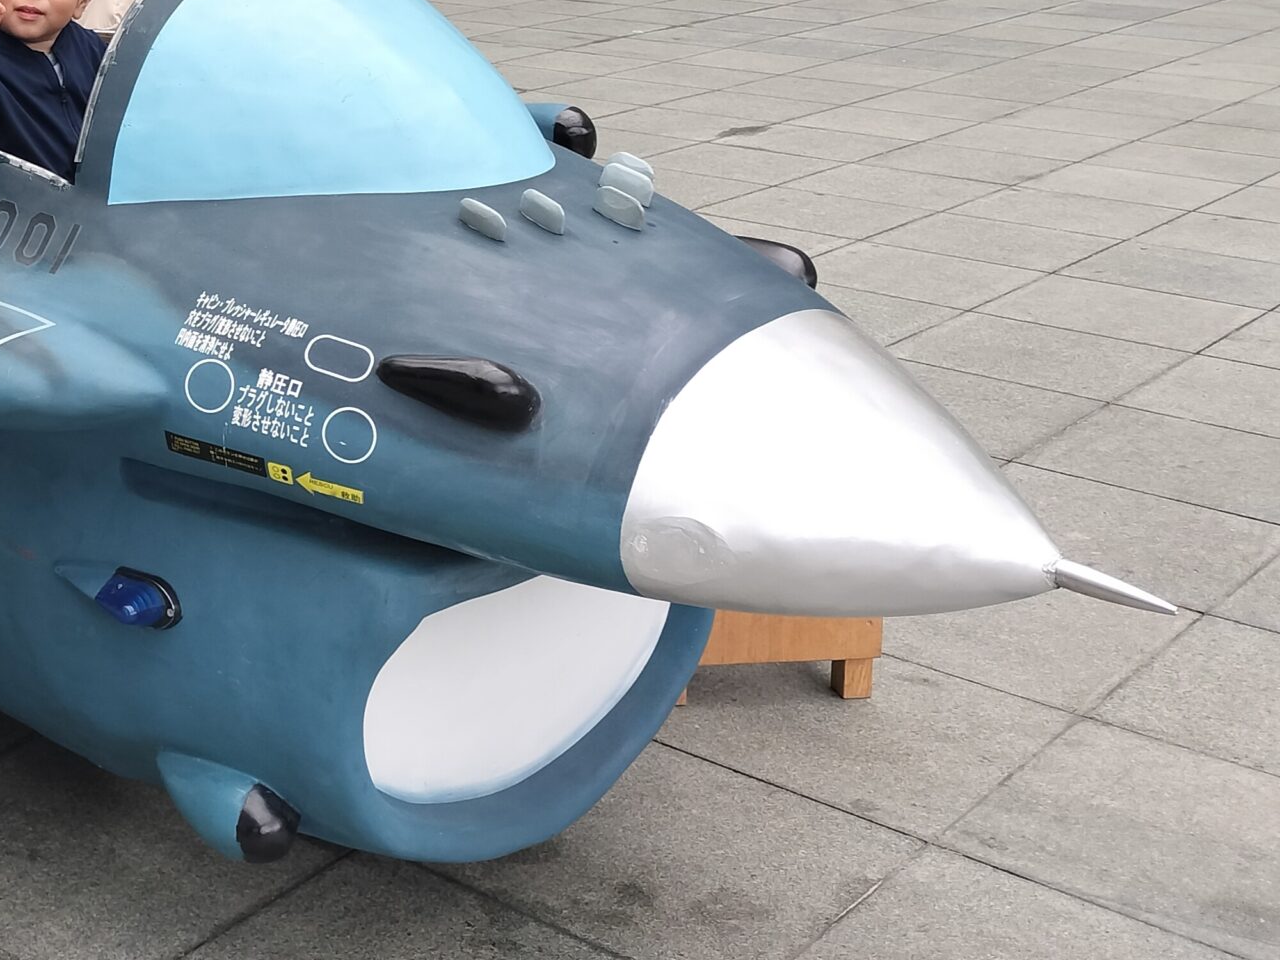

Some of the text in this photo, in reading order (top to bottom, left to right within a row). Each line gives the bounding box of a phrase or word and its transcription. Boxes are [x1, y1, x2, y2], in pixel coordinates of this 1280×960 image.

[256, 368, 304, 399] 静圧口
[231, 404, 310, 448] 変形させないこと
[237, 384, 315, 427] プラグしないこと
